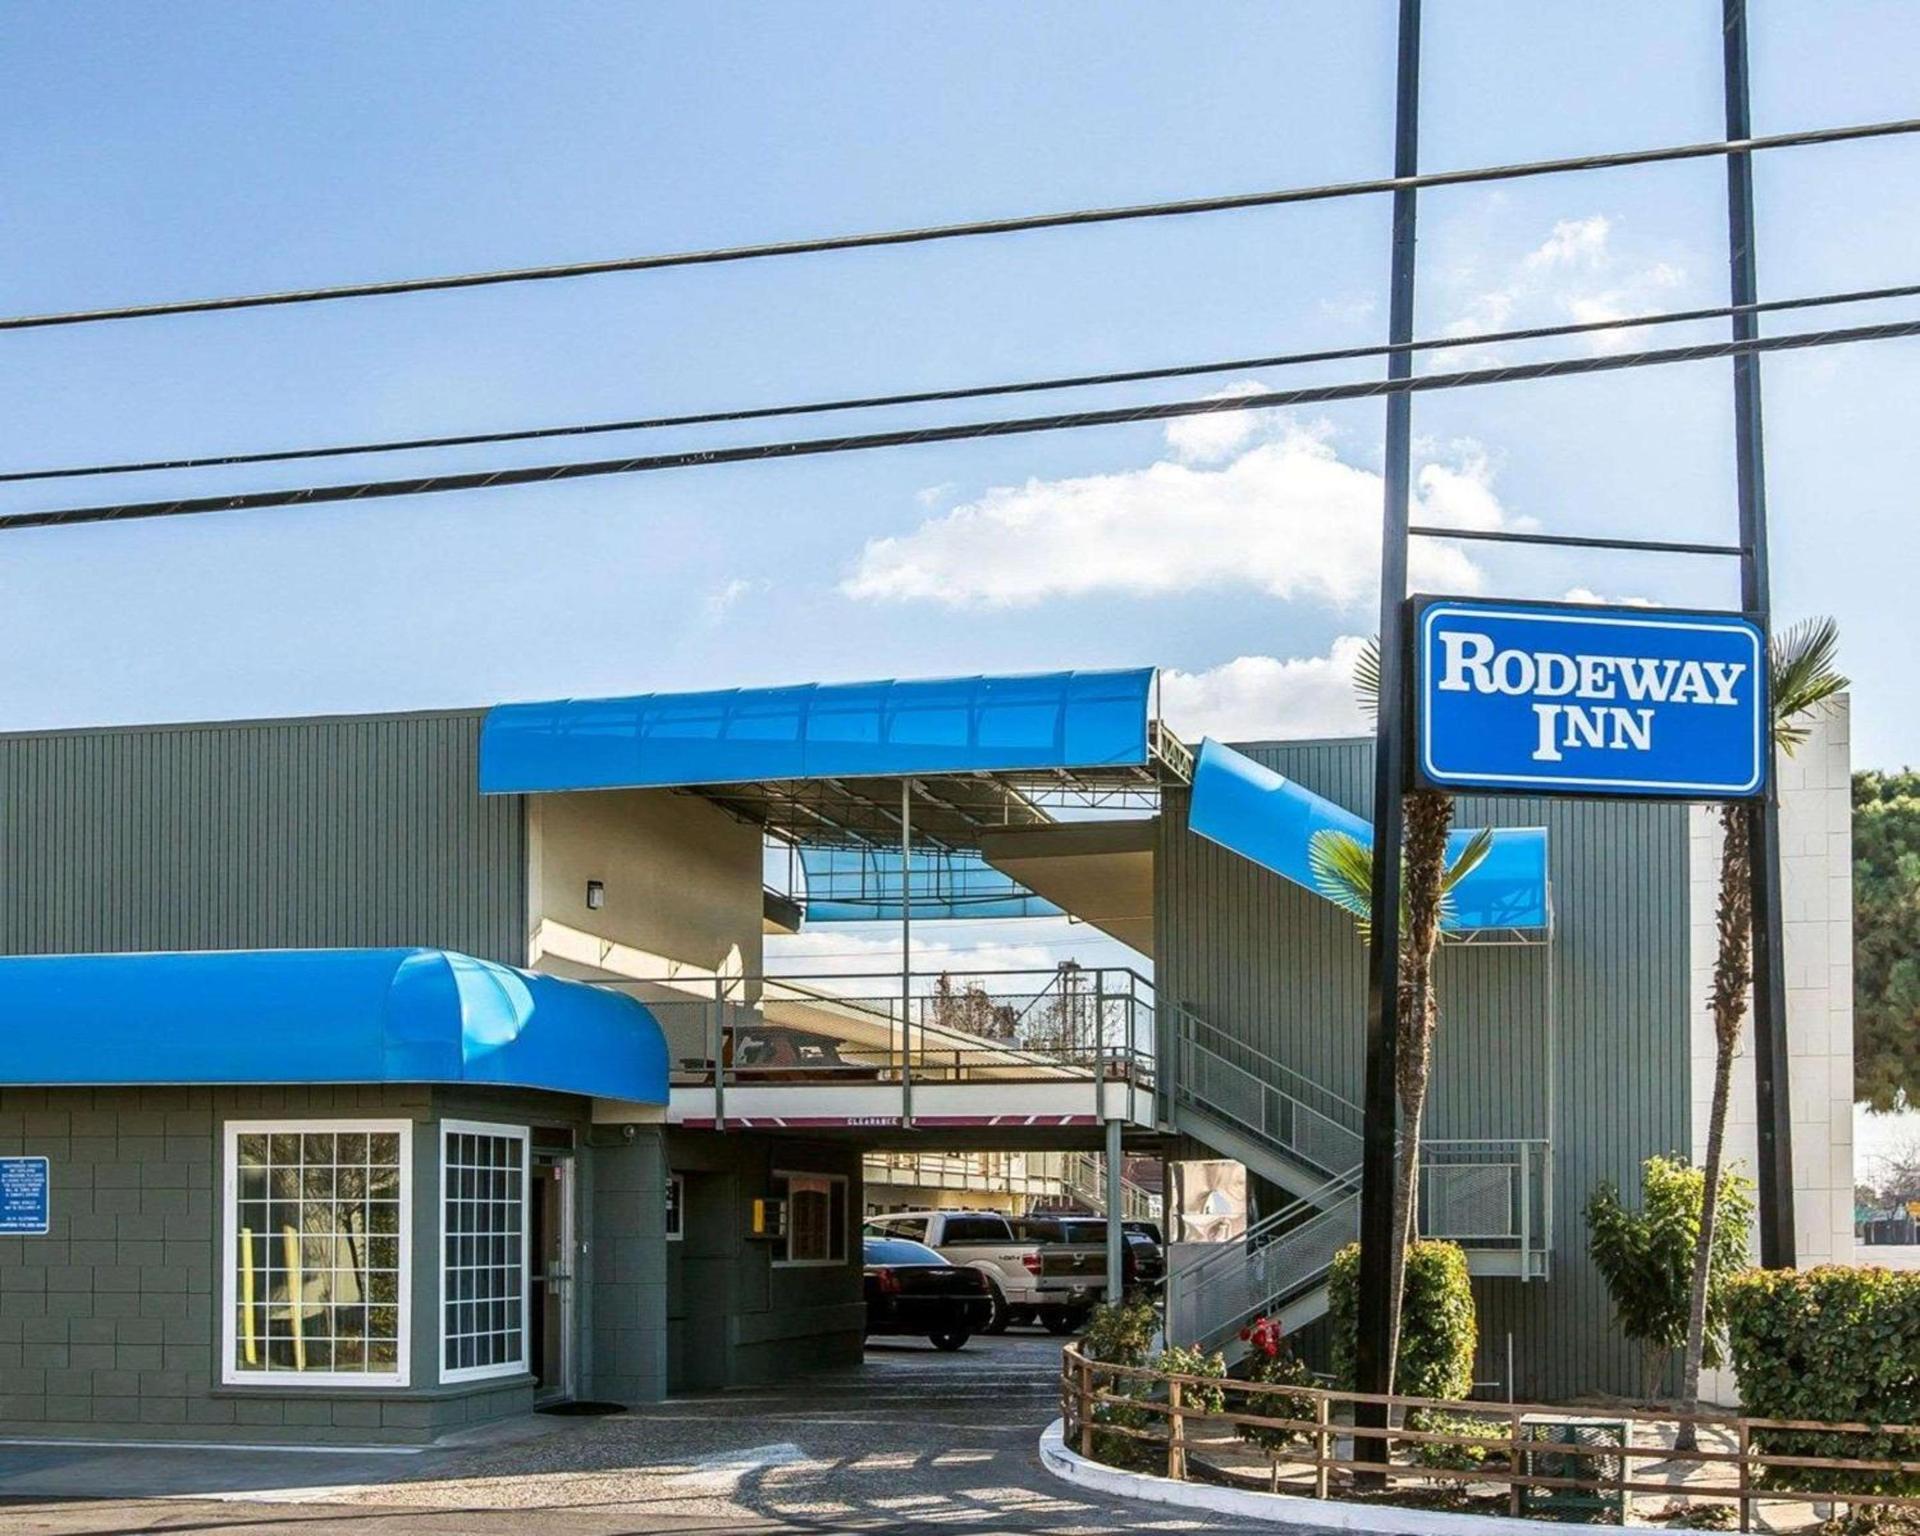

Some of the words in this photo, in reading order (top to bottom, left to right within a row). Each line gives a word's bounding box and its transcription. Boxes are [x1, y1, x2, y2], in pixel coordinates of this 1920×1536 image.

[1438, 631, 1746, 706] RODEWAY
[1532, 703, 1655, 762] INN
[847, 1117, 897, 1126] CLEARANCE
